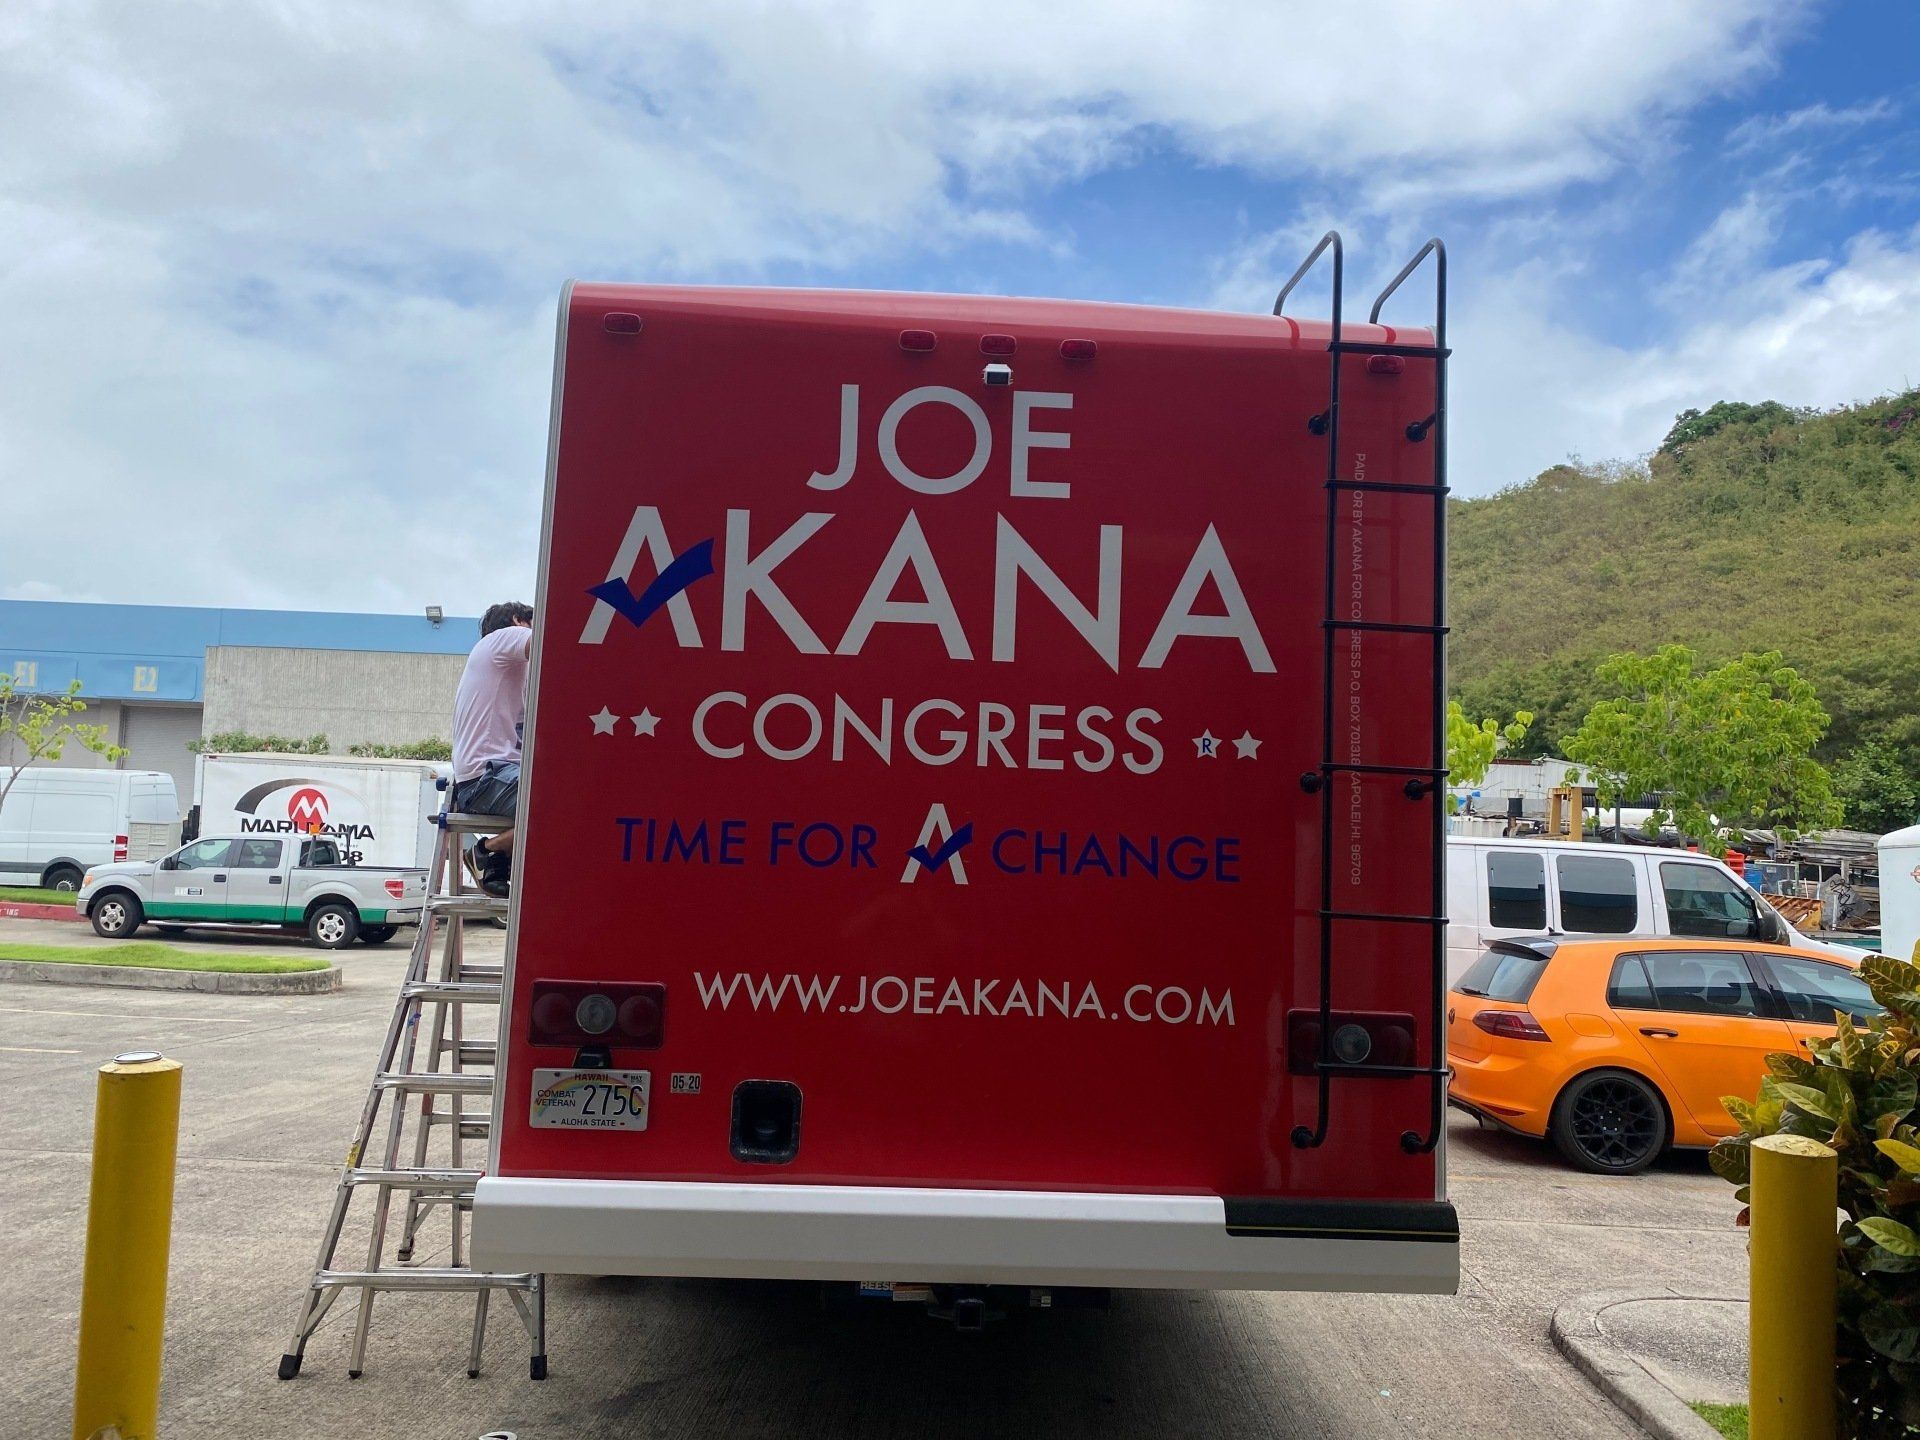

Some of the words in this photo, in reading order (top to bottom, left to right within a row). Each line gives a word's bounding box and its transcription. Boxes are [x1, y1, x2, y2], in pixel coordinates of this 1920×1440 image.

[807, 384, 1073, 498] JOE
[1354, 453, 1366, 481] PAID
[1353, 484, 1363, 508] OR
[1352, 509, 1362, 526] BY
[1352, 528, 1362, 572] AKANA
[578, 506, 1278, 674] AKANA
[1352, 573, 1362, 598] FOR
[1350, 670, 1360, 693] P.O.
[1350, 695, 1360, 721] BOX
[692, 691, 1164, 775] CONGRESS
[1202, 737, 1213, 754] R
[615, 817, 747, 866] TIME
[768, 821, 879, 869] FOR
[900, 802, 974, 885] A
[991, 828, 1241, 883] CHANGE
[1351, 844, 1361, 885] 96709
[693, 972, 1236, 1026] WWW.JOEAKANA.COM
[574, 1073, 609, 1081] HAWAII
[536, 1098, 576, 1107] VETERAN
[537, 1089, 576, 1098] COMBAT
[582, 1084, 643, 1116] 275C
[561, 1118, 589, 1126] ALOHA
[591, 1119, 617, 1127] STATE
